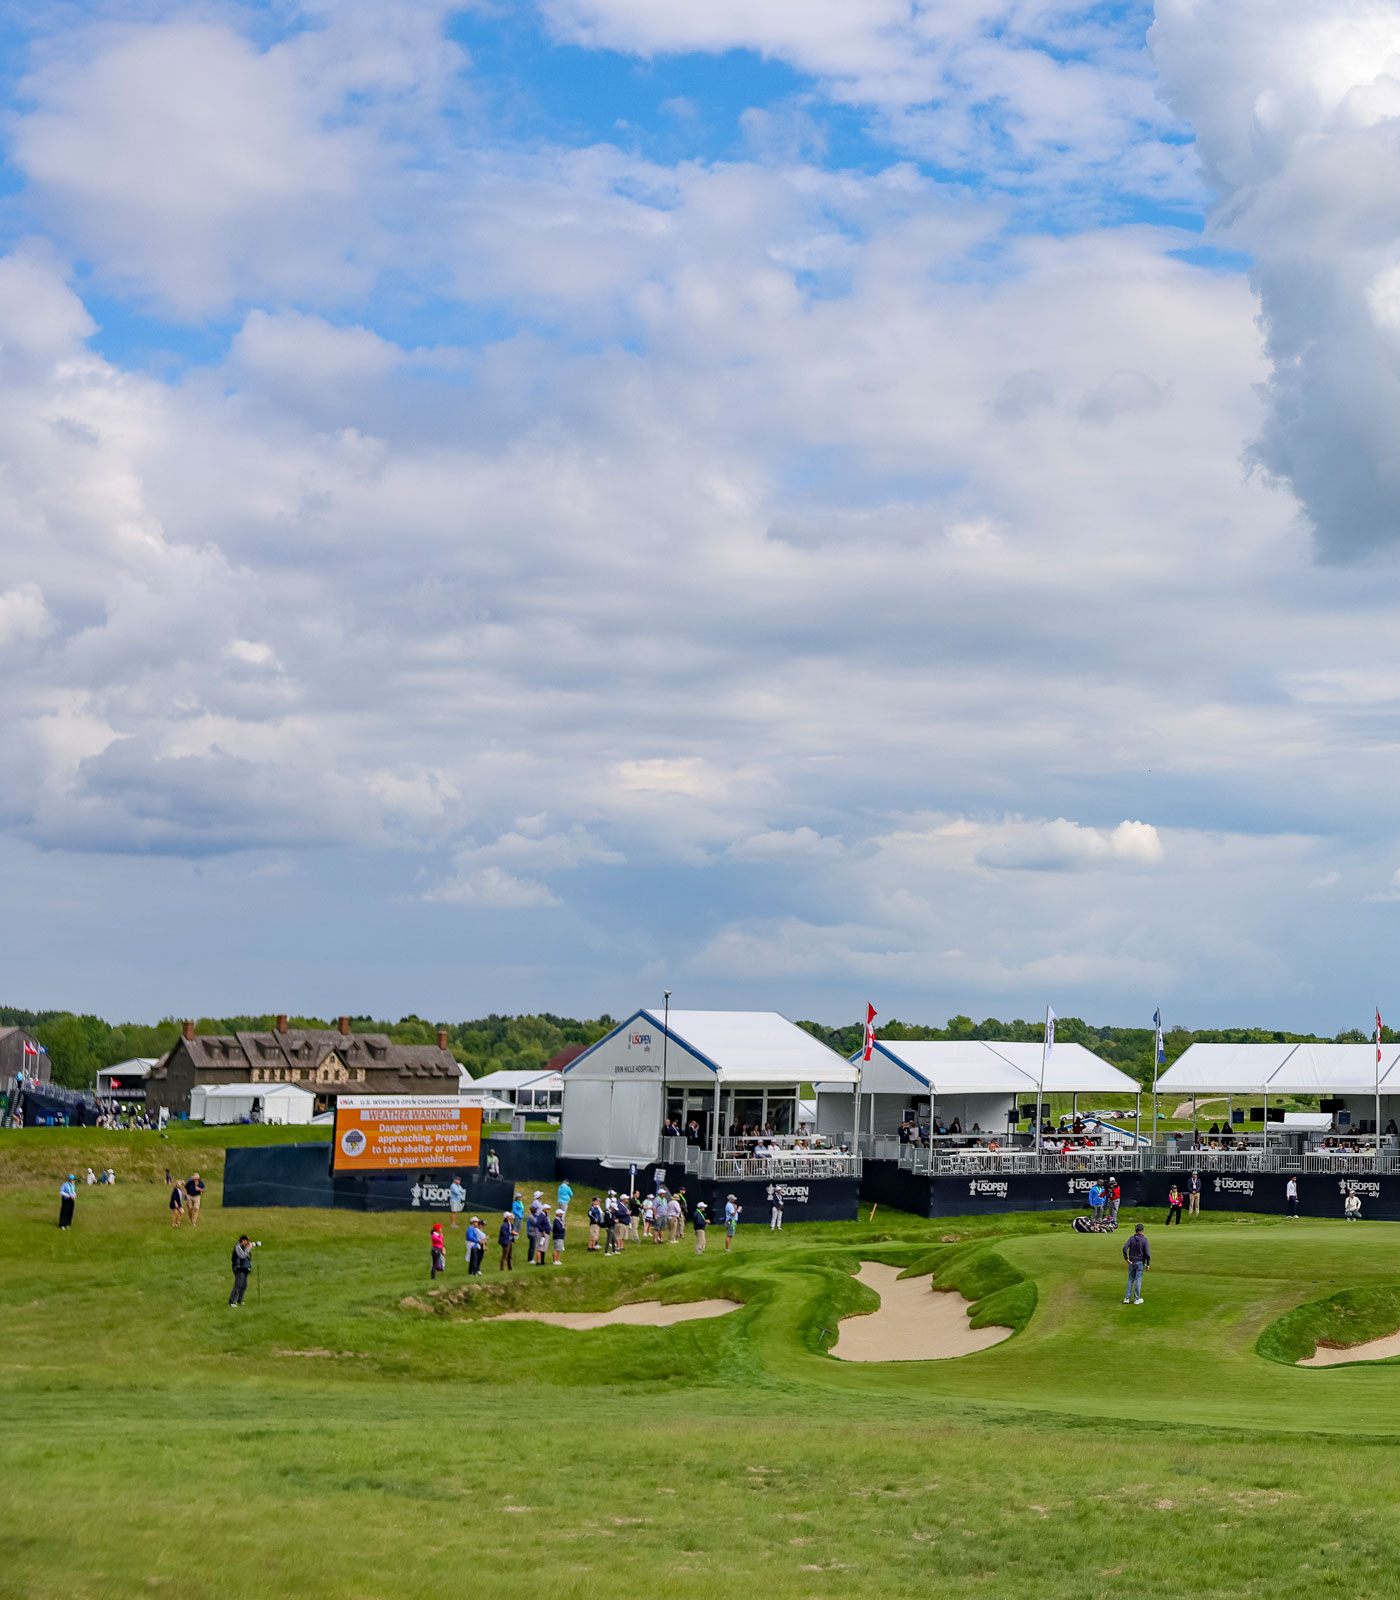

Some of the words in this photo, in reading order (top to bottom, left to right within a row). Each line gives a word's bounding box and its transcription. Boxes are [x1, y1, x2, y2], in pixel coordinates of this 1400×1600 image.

[368, 1109, 410, 1120] WEATHER
[411, 1109, 453, 1120] WARNING
[379, 1123, 424, 1135] Dangerous
[425, 1122, 459, 1132] weather
[461, 1121, 468, 1131] is
[378, 1134, 433, 1145] approaching.
[435, 1133, 468, 1143] Prepare
[372, 1146, 381, 1154] to
[383, 1144, 401, 1154] take
[403, 1144, 433, 1153] shelter
[446, 1144, 472, 1152] return
[388, 1156, 398, 1164] to
[399, 1157, 418, 1166] your
[420, 1154, 456, 1164] vehicles.
[977, 1182, 1008, 1191] USOPEN
[1075, 1180, 1098, 1189] USOP
[1221, 1180, 1254, 1189] USOPEN
[1347, 1182, 1380, 1191] USOPEN
[422, 1188, 466, 1201] USOP
[778, 1186, 809, 1196] SOPEN
